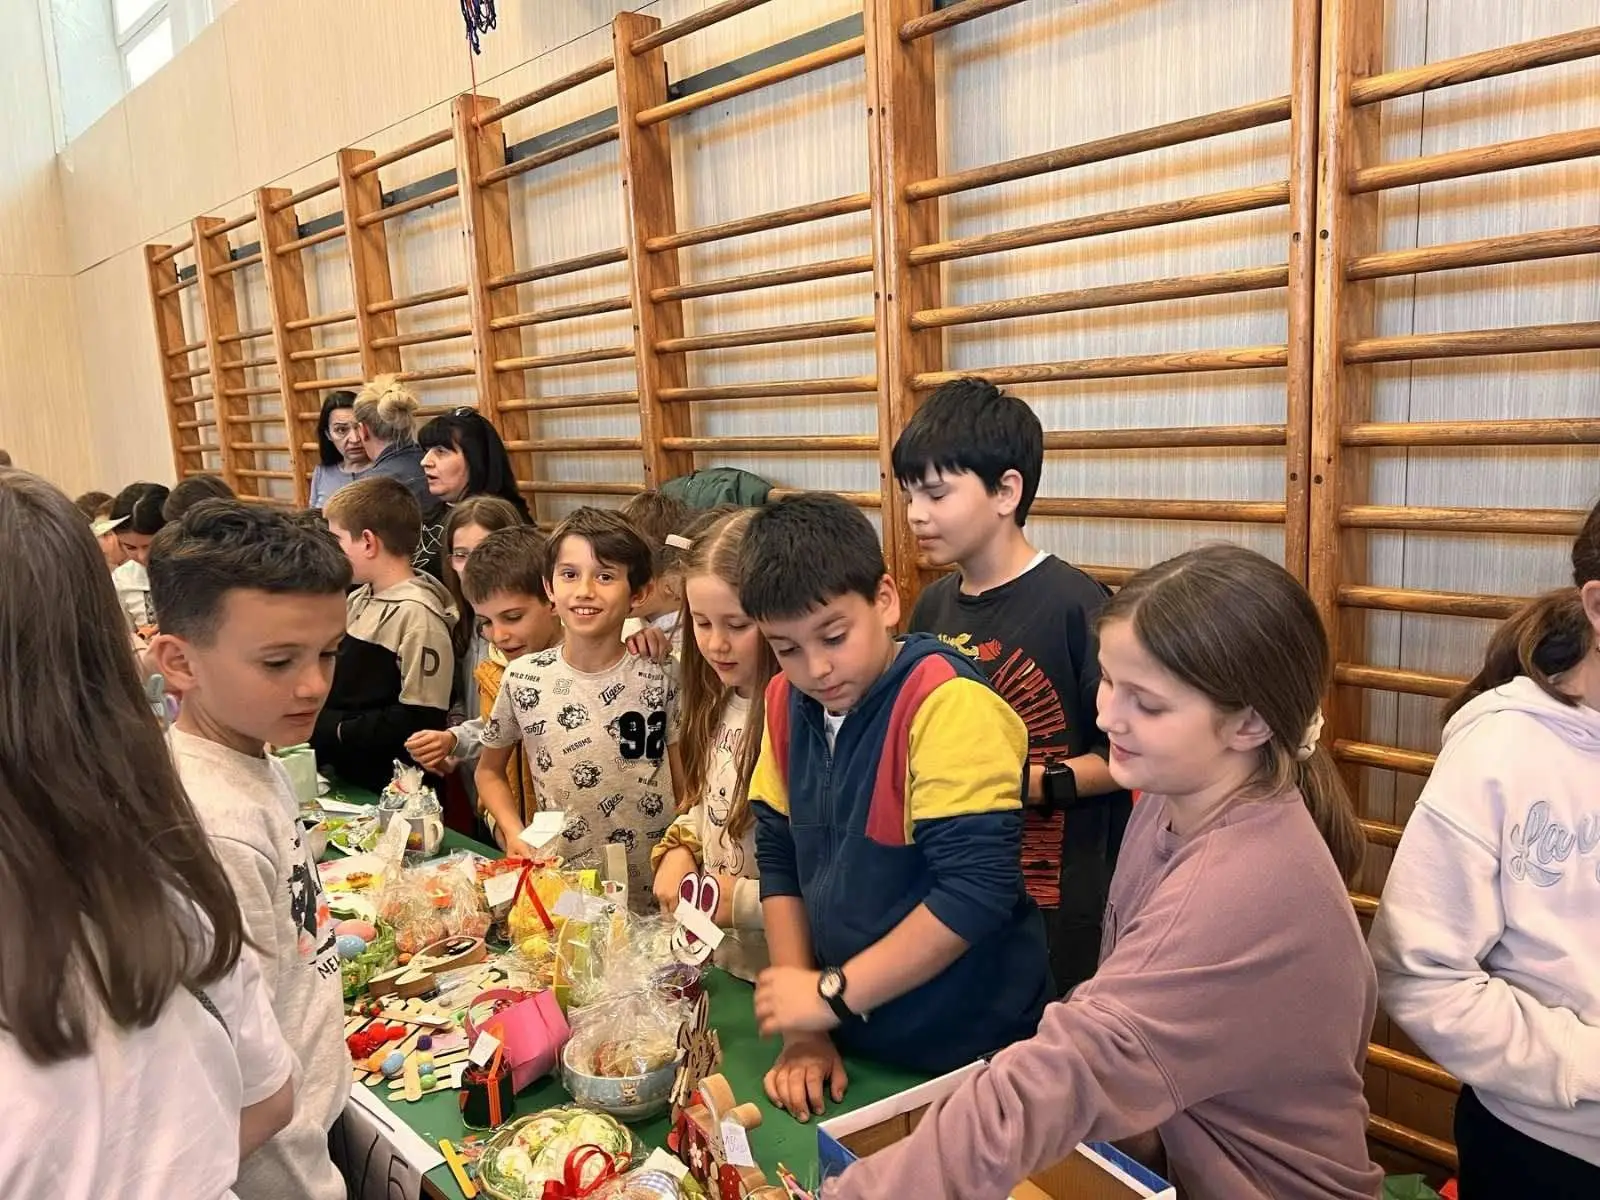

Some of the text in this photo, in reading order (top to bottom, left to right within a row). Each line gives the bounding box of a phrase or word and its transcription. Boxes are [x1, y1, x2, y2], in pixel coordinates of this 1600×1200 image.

[598, 682, 626, 706] Tiger
[562, 736, 593, 755] AWESOME
[619, 711, 667, 760] 92
[597, 793, 624, 818] Tiger
